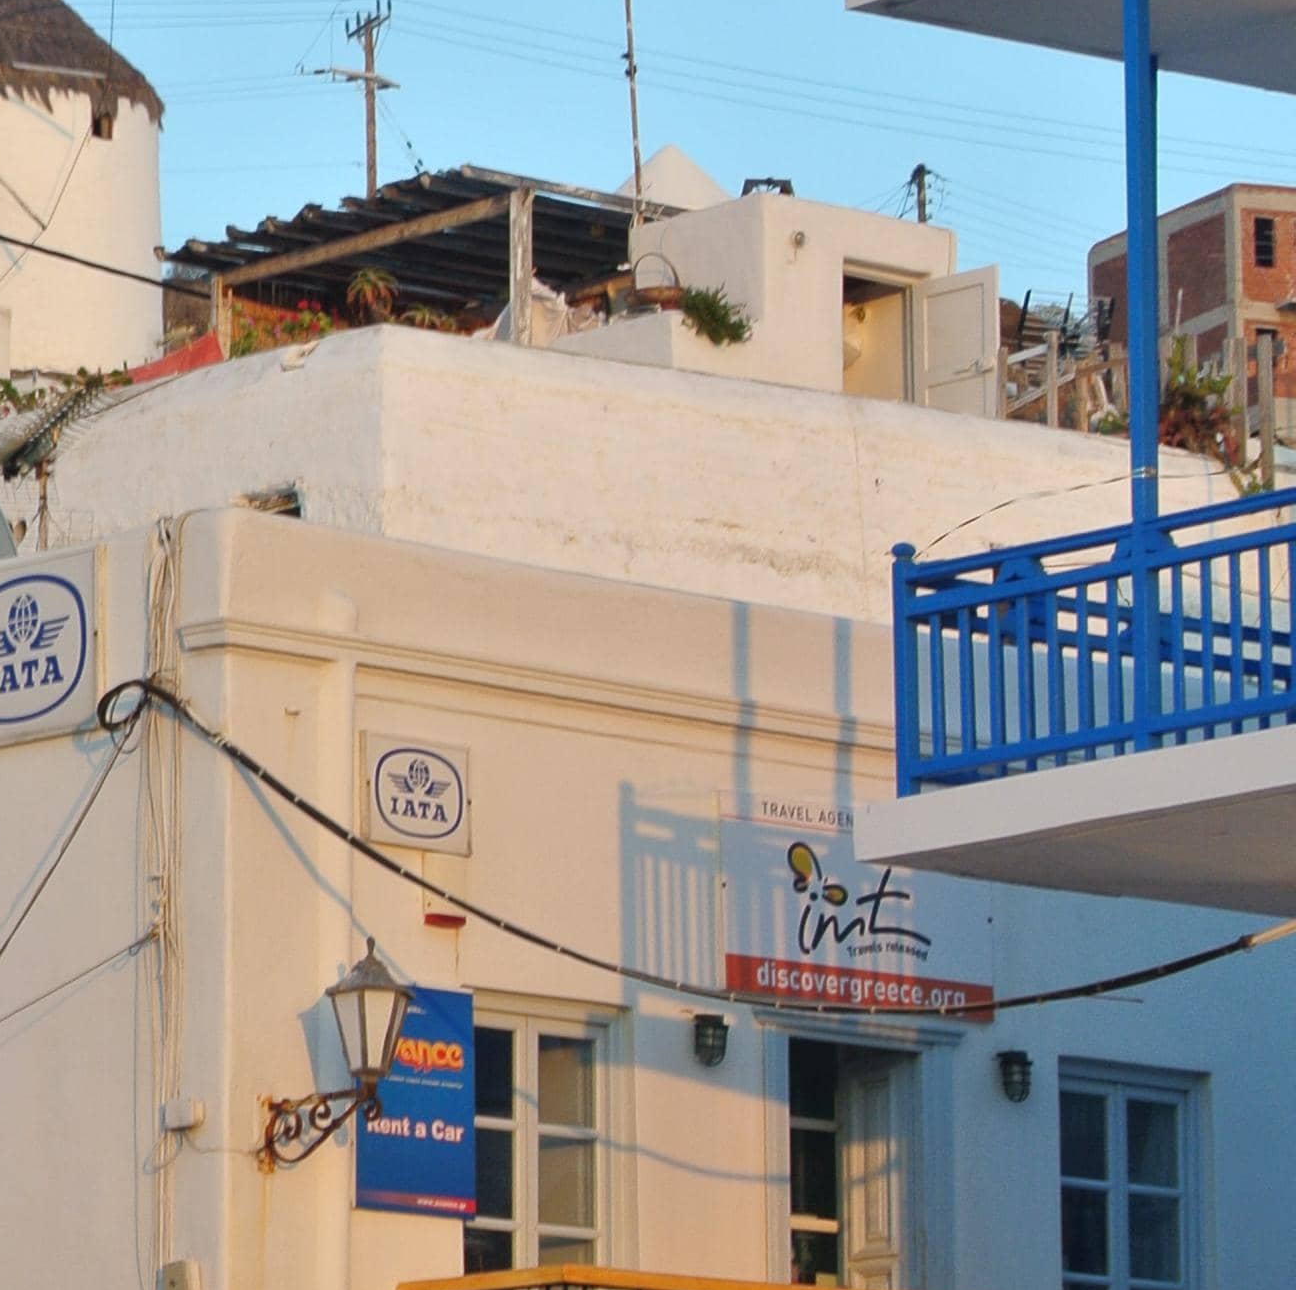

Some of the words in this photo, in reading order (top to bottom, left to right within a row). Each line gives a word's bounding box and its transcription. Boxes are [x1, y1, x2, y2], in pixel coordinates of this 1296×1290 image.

[390, 796, 448, 822] IATA
[761, 801, 812, 823] TRAVEL
[798, 866, 931, 955] imt
[757, 961, 966, 1007] discovergreece.org
[367, 1115, 410, 1138] Rent
[415, 1121, 427, 1139] a
[432, 1118, 464, 1143] Car
